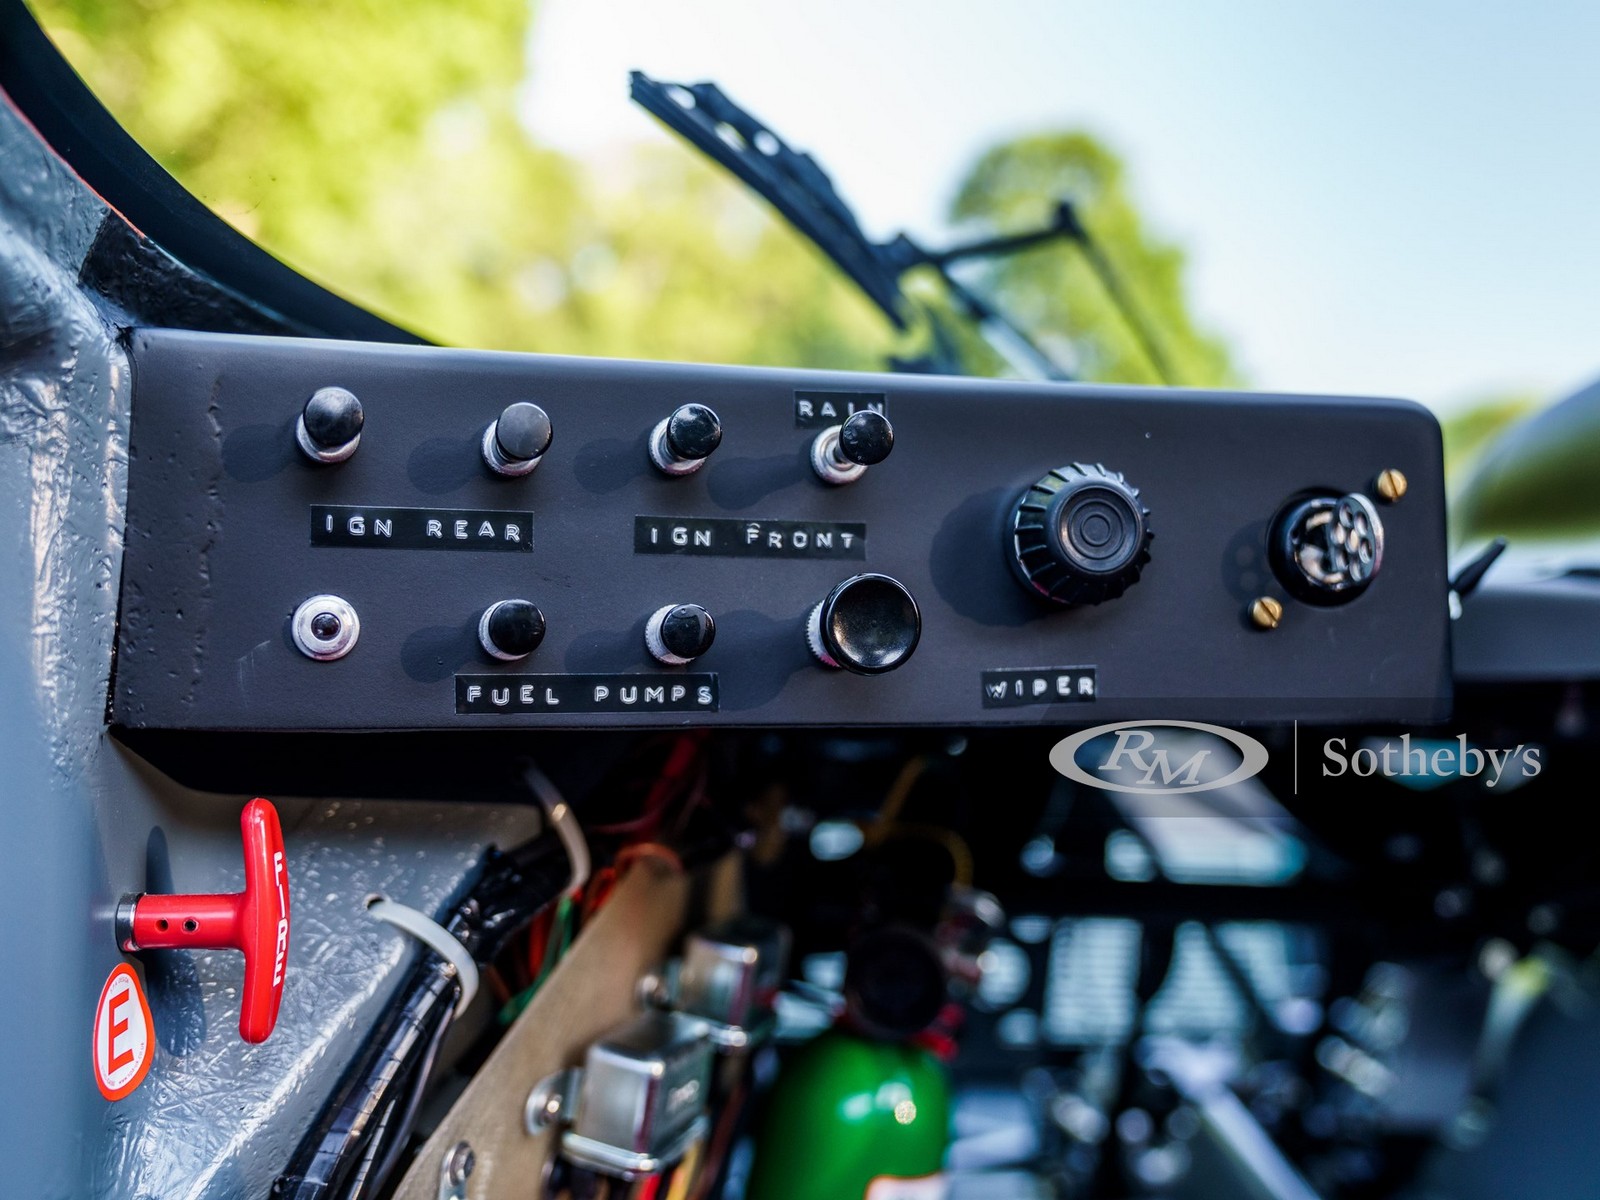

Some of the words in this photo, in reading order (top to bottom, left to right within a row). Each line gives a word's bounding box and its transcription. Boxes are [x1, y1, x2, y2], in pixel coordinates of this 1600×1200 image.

[798, 399, 883, 417] RAIN
[325, 513, 393, 538] IGN
[426, 519, 521, 544] REAR
[650, 526, 713, 547] IGN
[745, 526, 855, 549] FRONT
[466, 684, 560, 707] FUEL
[593, 684, 713, 705] PUMPS
[985, 675, 1094, 699] WIPER
[273, 851, 289, 988] FIRE
[108, 988, 134, 1076] E
